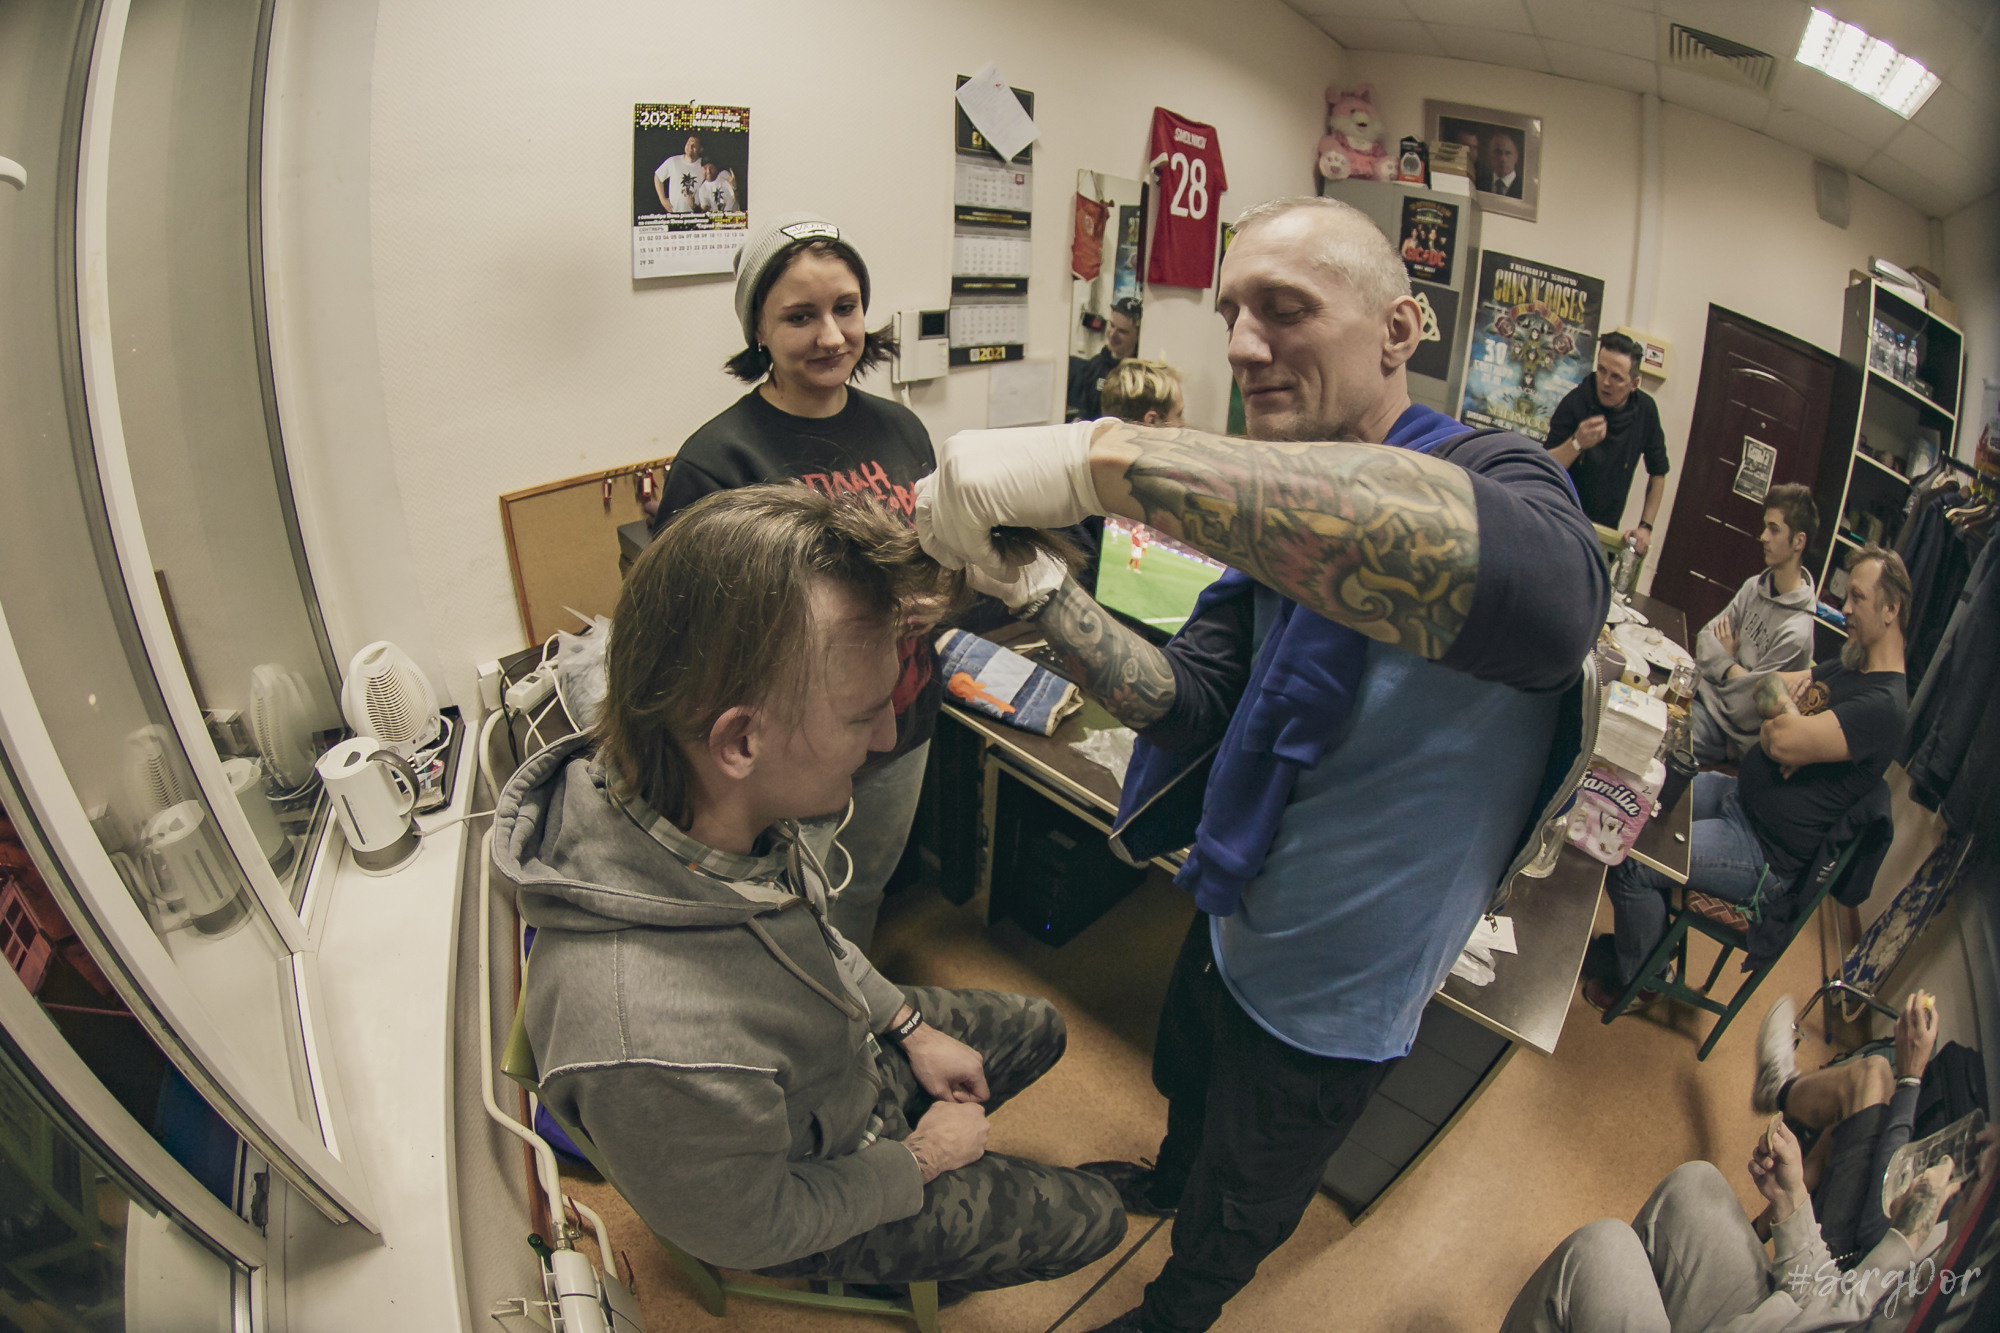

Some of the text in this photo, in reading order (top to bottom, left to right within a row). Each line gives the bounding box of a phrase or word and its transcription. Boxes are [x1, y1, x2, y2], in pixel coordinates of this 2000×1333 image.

[640, 111, 675, 126] 2021
[1170, 152, 1209, 220] 28
[1494, 268, 1529, 305] GUNS
[980, 346, 1006, 361] 2021
